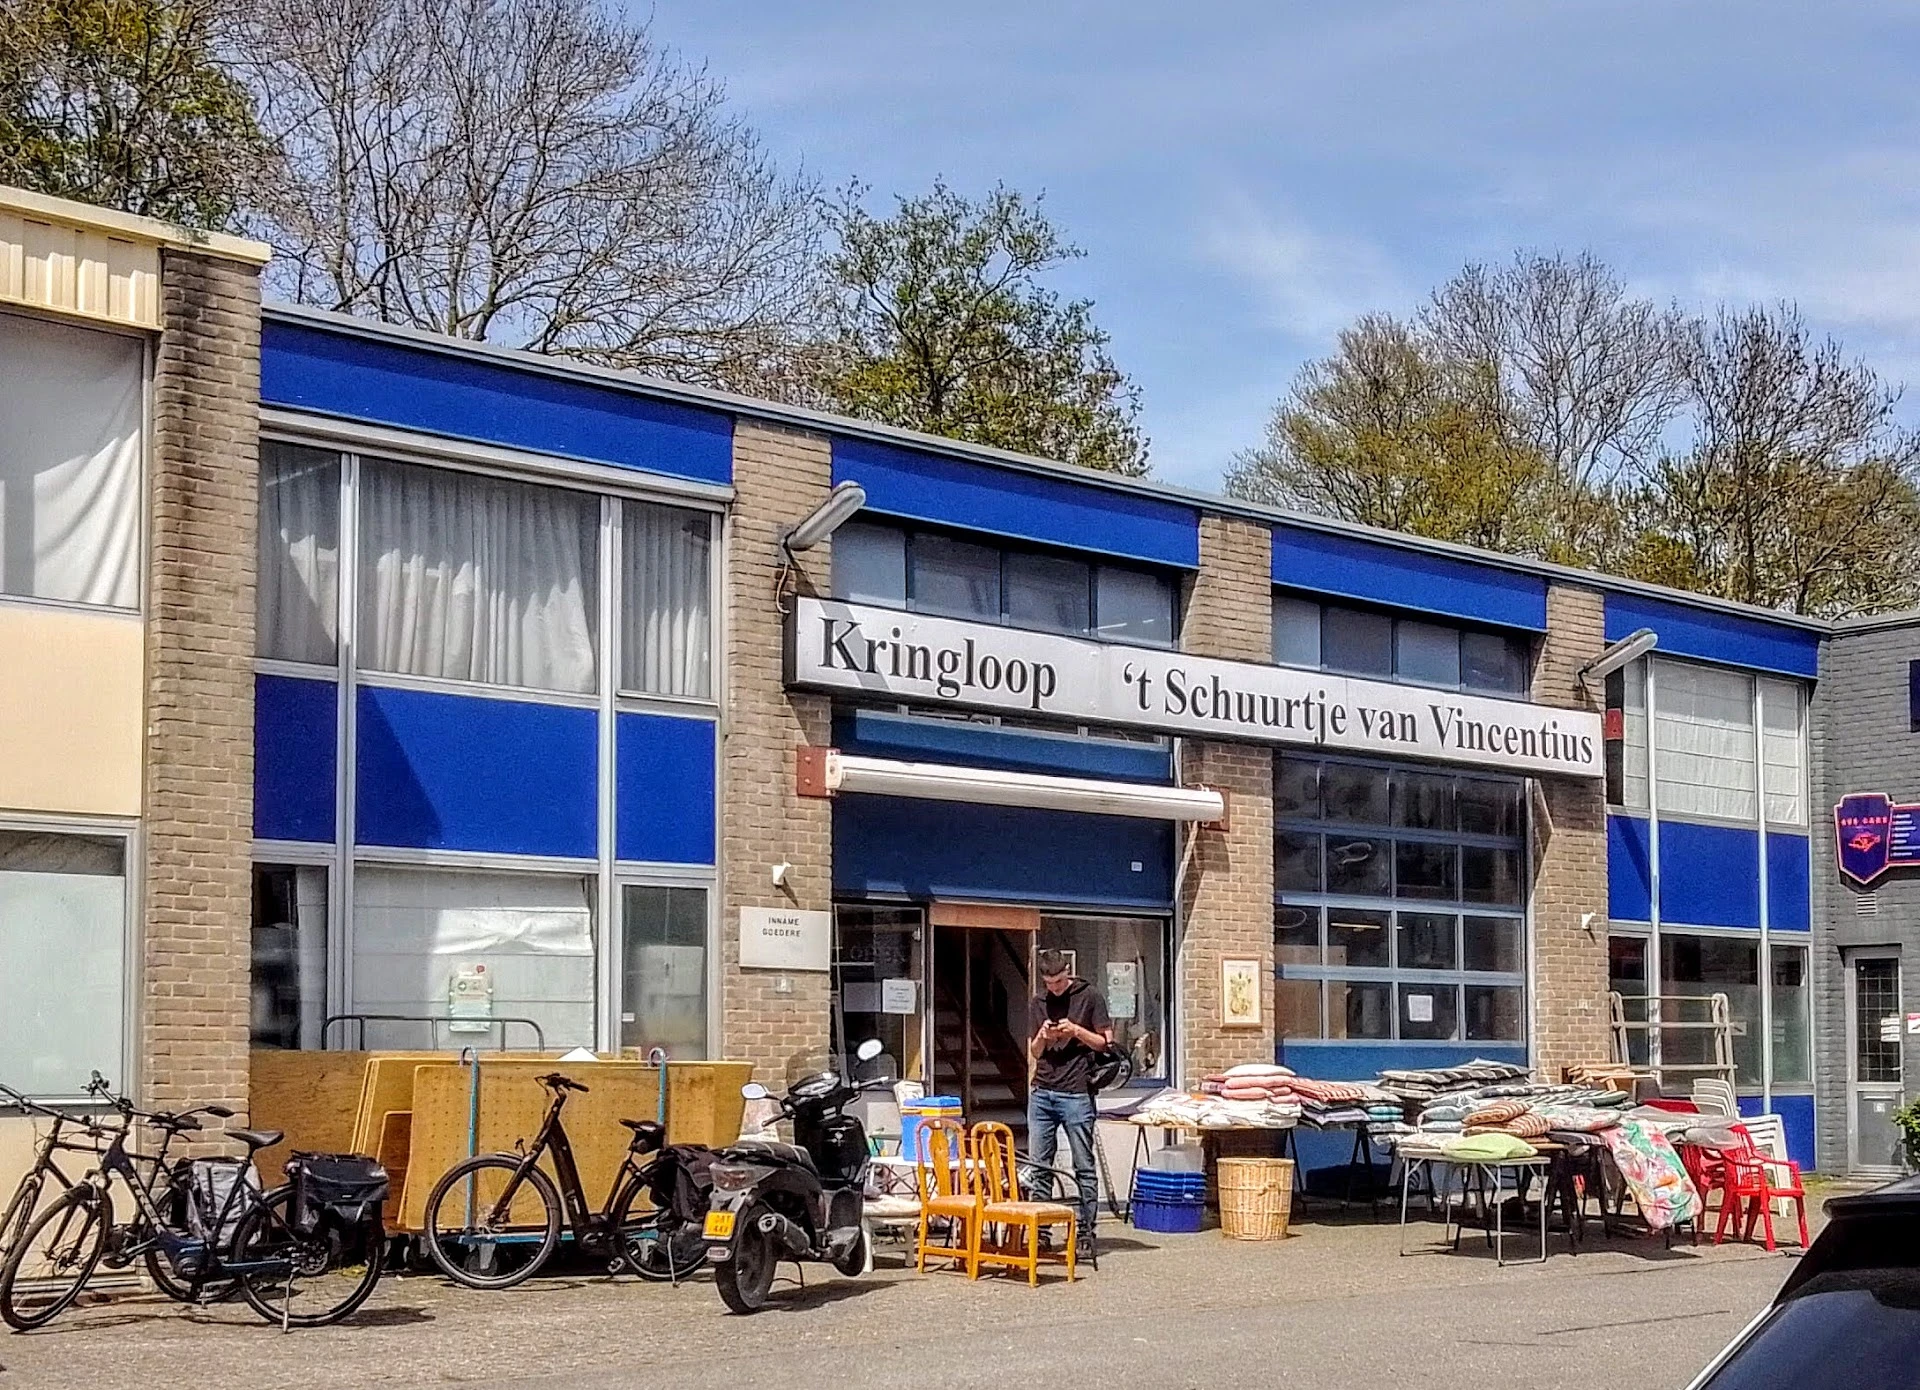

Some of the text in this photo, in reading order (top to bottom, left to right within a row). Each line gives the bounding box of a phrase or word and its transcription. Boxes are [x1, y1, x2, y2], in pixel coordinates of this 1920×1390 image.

[818, 616, 1057, 709] Kringloop
[1165, 668, 1347, 744] Schuurtje
[1358, 706, 1418, 743] van
[1428, 705, 1594, 763] Vincentius
[768, 917, 799, 926] INNAME
[762, 928, 801, 937] GOEDERE
